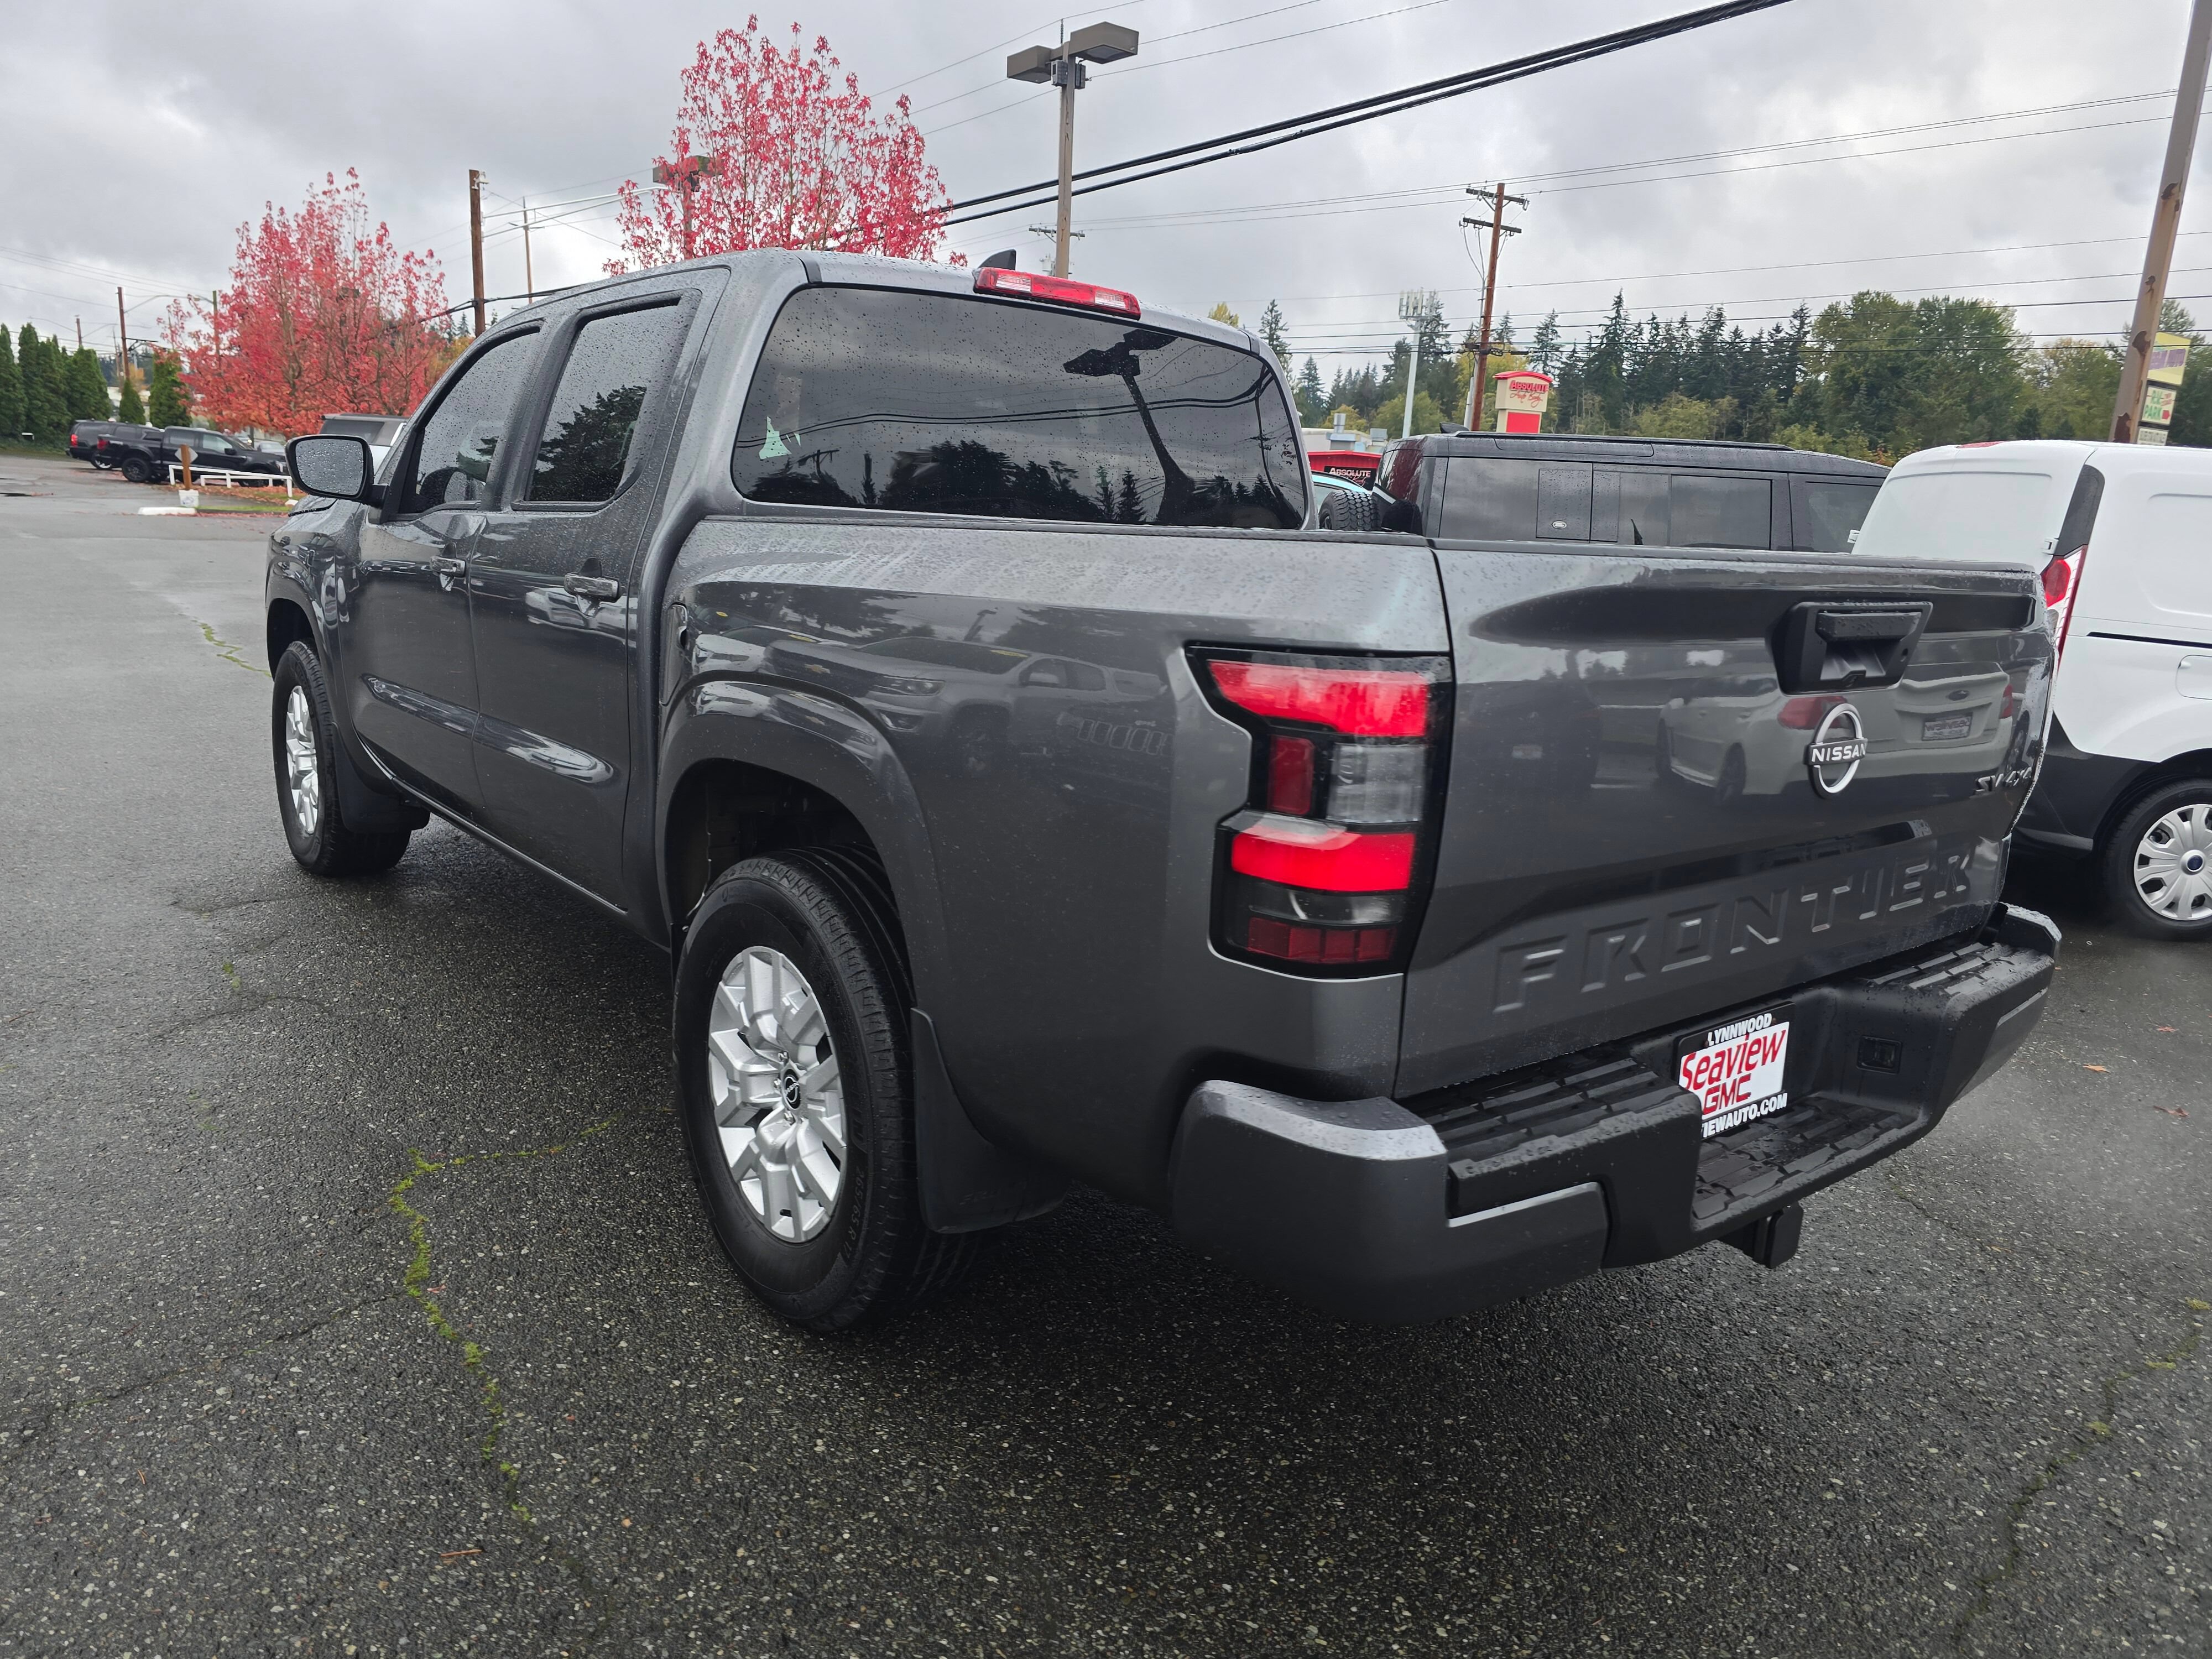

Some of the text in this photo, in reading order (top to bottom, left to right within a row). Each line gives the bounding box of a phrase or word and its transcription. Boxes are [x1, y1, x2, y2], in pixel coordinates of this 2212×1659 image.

[1509, 380, 1548, 392] ABSOLUTE
[1329, 467, 1371, 477] ABSOLUTE
[1812, 743, 1866, 763] NISSAN
[1492, 847, 1973, 1013] FRONTIER
[1707, 1013, 1772, 1046] LYNNWOOD
[1682, 1029, 1786, 1091] Seaview
[1703, 1073, 1751, 1115] GMC
